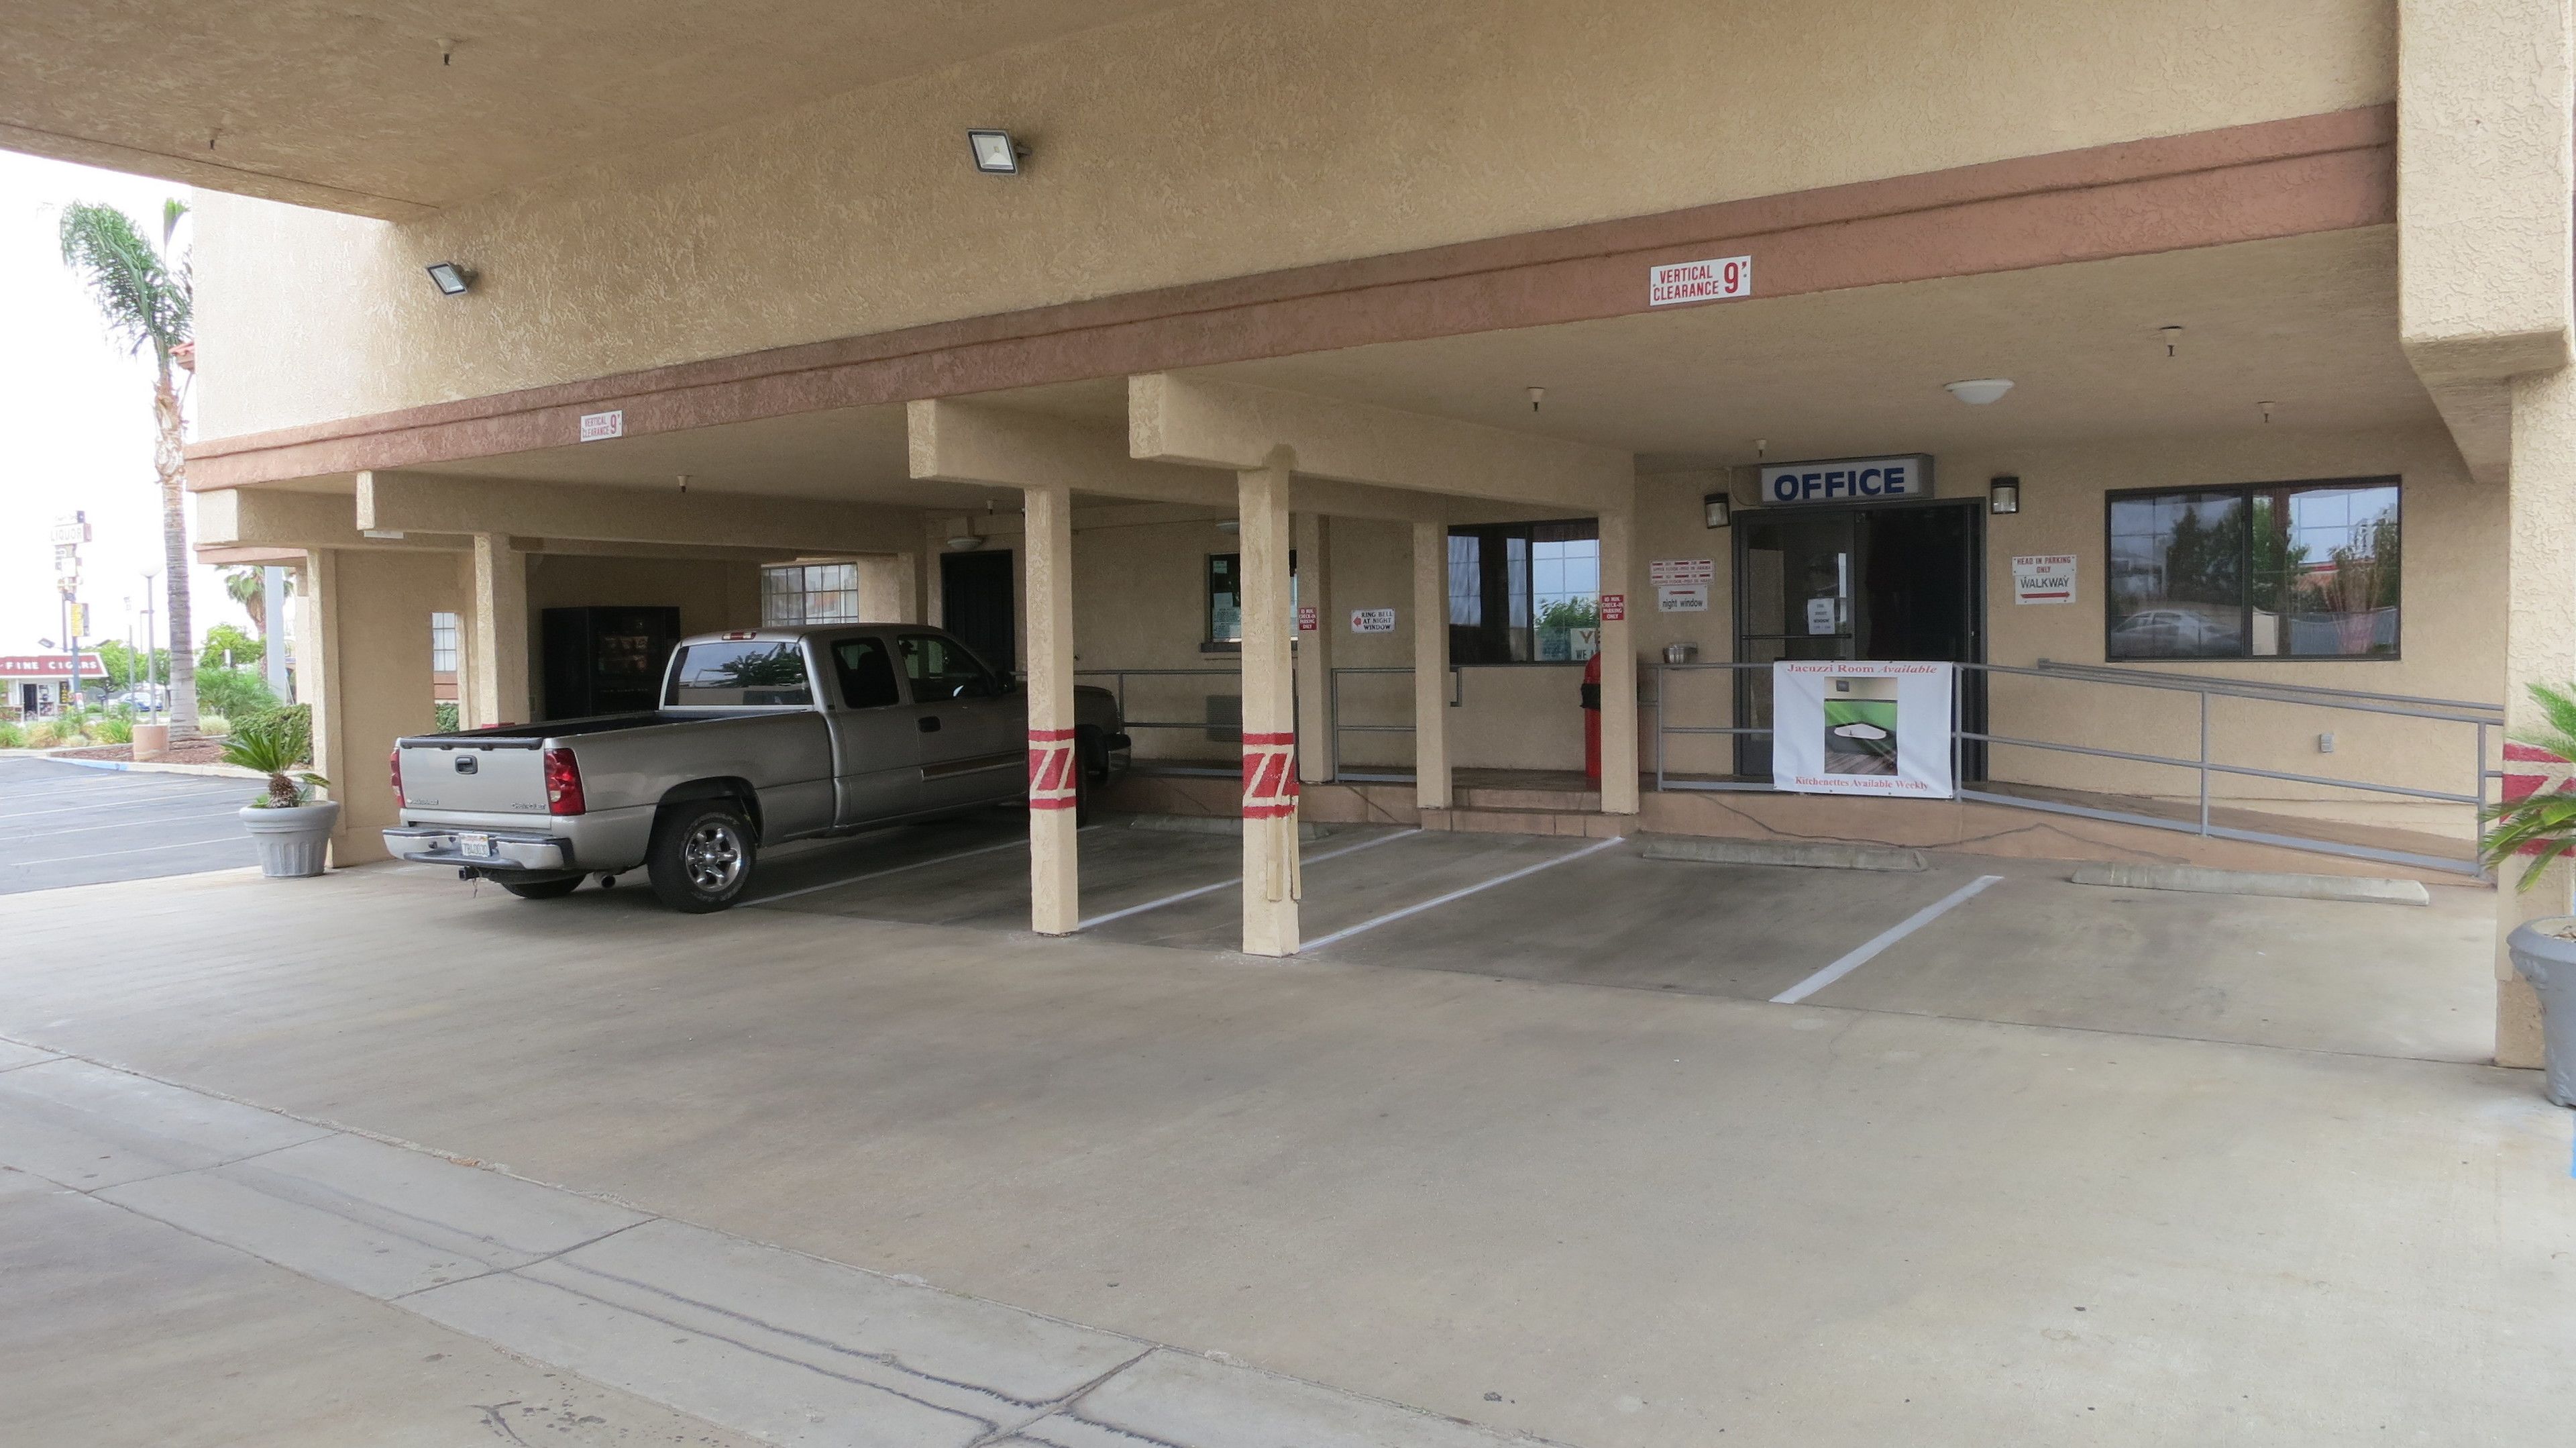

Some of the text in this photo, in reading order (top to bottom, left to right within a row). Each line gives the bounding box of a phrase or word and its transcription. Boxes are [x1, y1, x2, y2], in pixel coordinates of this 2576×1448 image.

[1660, 265, 1713, 285] VERTICAL
[1654, 280, 1719, 301] CLEARANCE
[1774, 467, 1904, 501] OFFICE
[51, 527, 82, 541] LIQUOR
[2045, 556, 2072, 564] PARKING
[2020, 577, 2070, 588] WALKWAY
[1662, 598, 1703, 609] night window
[6, 661, 97, 670] FINE CIGRS
[1788, 664, 1937, 674] Jacuzzi Room Available
[1795, 776, 1929, 790] Kitchenettes Available Weekly
